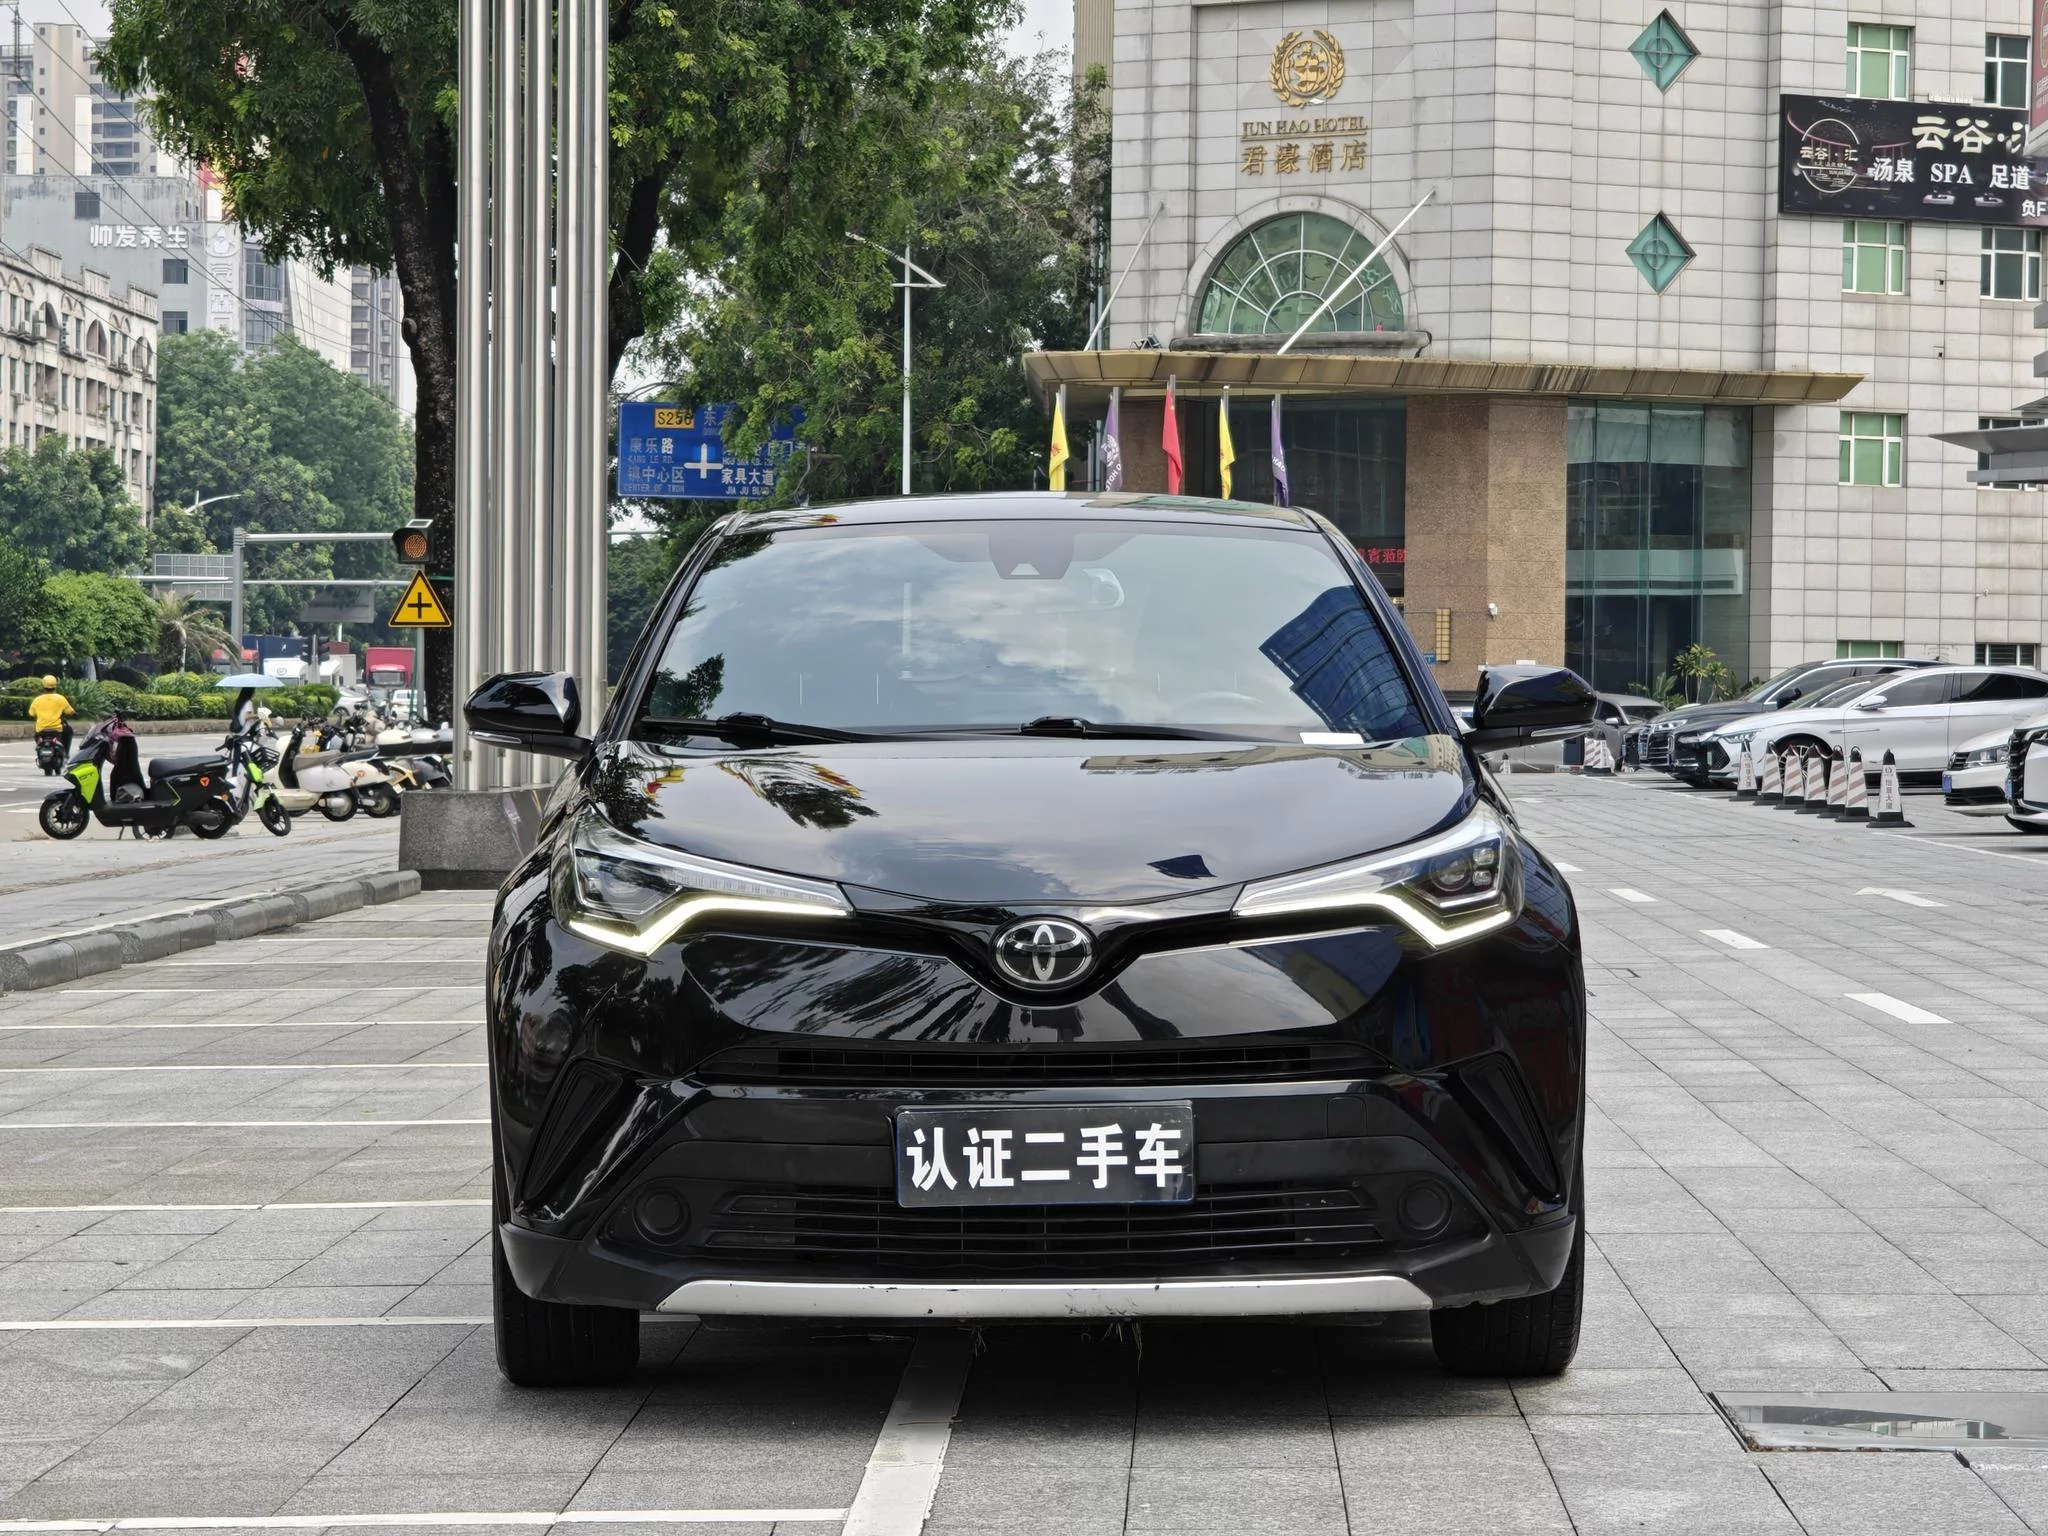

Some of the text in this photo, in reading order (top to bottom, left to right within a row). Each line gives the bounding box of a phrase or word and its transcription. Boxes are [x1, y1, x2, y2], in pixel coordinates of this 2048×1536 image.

[1242, 116, 1368, 139] JUN HAO HOTEL
[1873, 156, 1915, 184] 汤泉
[1930, 163, 1974, 186] SPA
[1989, 164, 2030, 191] 足道
[2021, 199, 2048, 218] 负F
[89, 224, 190, 249] 帅发养生
[721, 467, 774, 486] 家具大道
[906, 1123, 1183, 1191] 认证二手车
